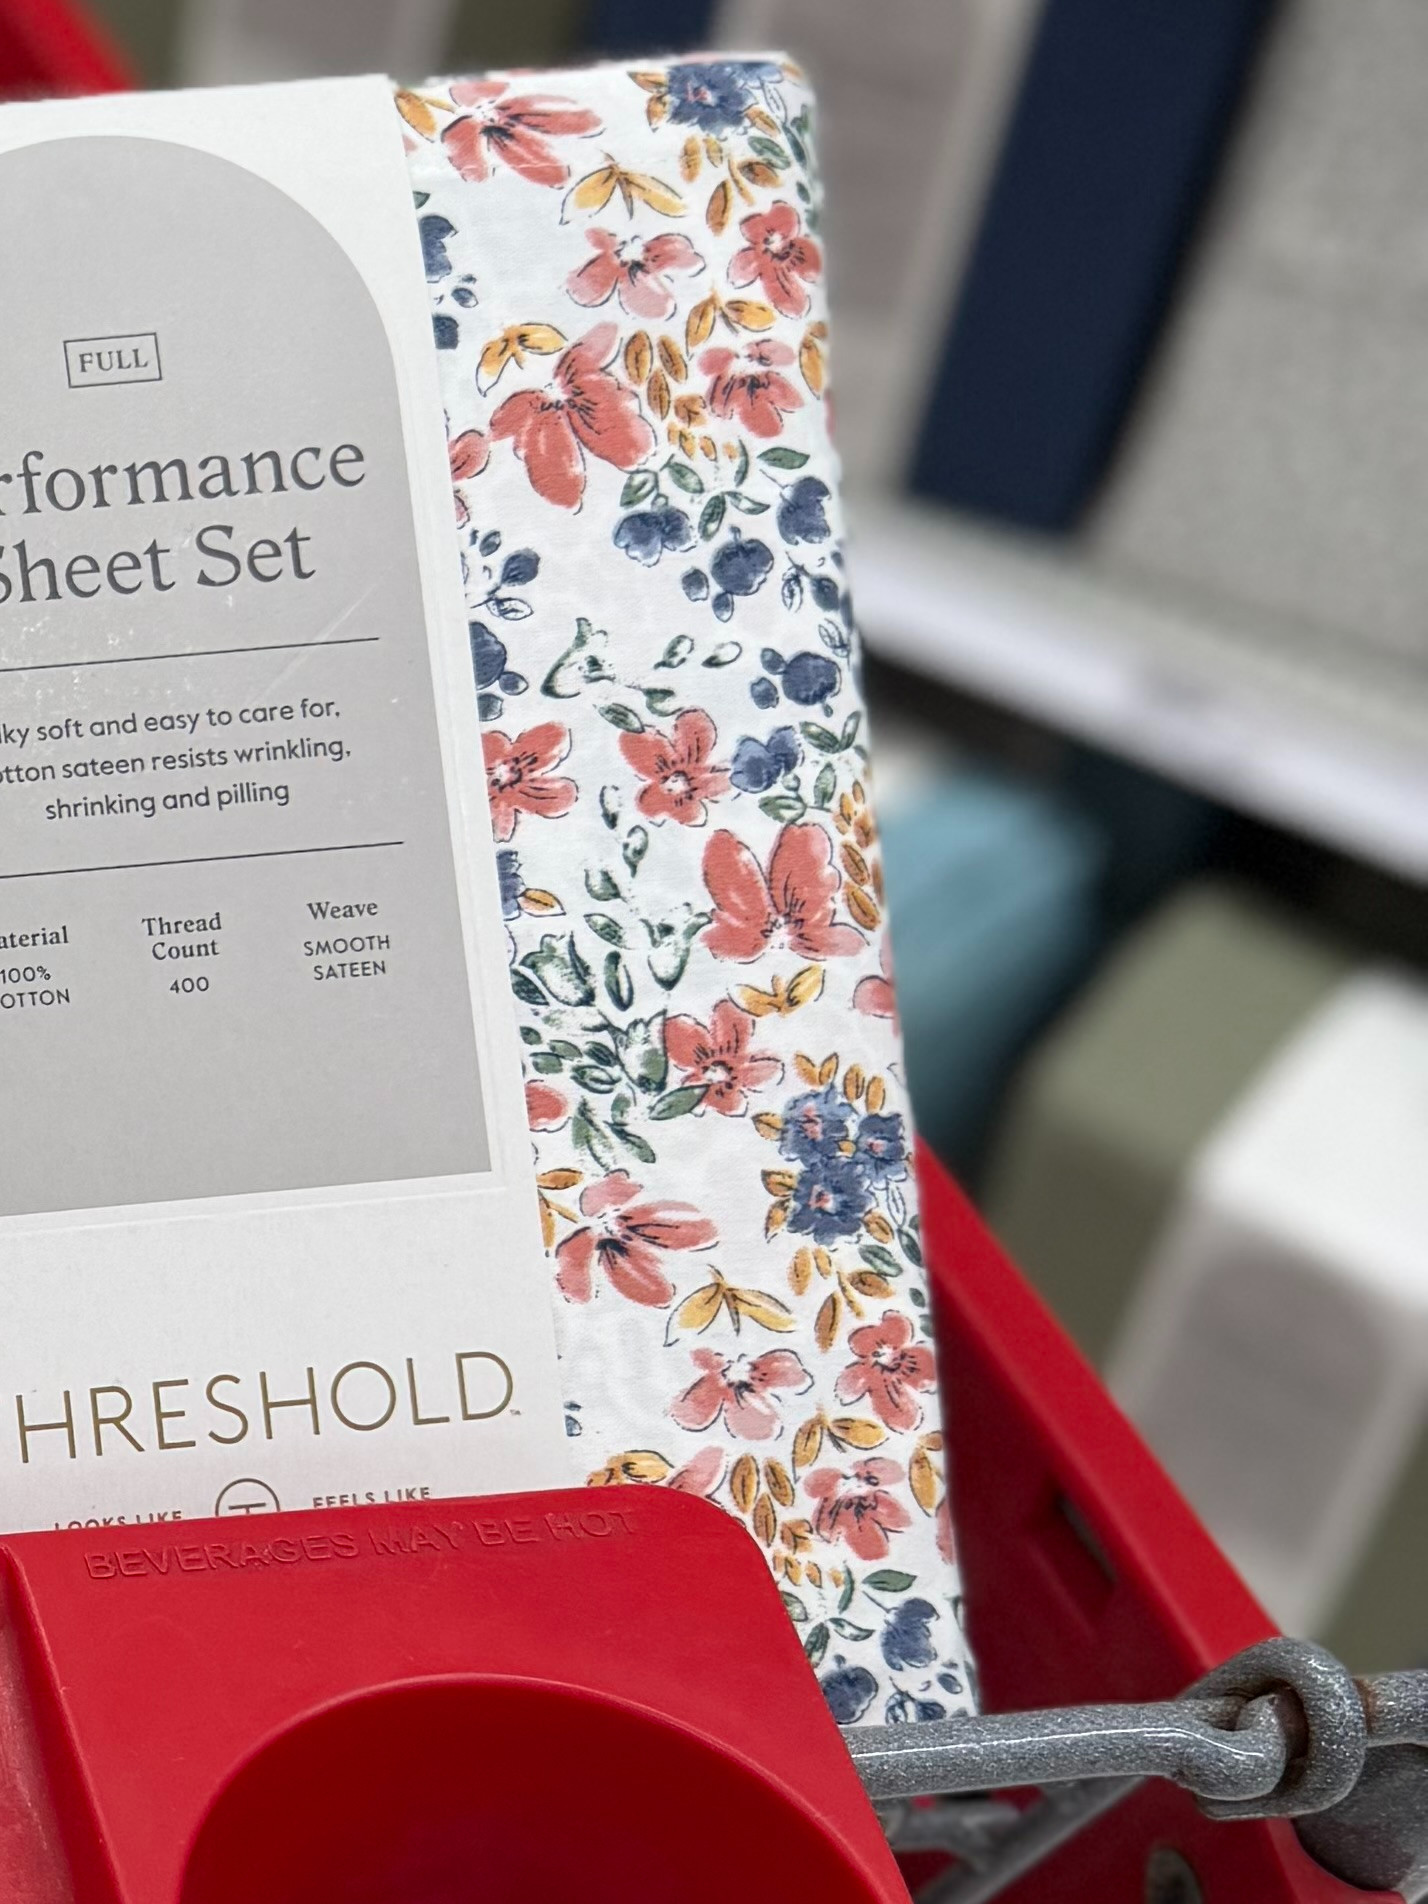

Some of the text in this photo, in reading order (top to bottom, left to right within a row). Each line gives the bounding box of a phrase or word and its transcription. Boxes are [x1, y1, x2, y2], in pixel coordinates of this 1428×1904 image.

[78, 348, 149, 373] FULL
[195, 524, 316, 587] Set
[36, 718, 85, 741] soft
[89, 712, 138, 737] and
[143, 712, 200, 735] easy
[205, 708, 233, 727] to
[238, 705, 294, 724] care
[300, 697, 341, 719] for,
[62, 757, 145, 779] sateen
[151, 747, 228, 771] resists
[233, 737, 351, 763] wrinkling,
[45, 781, 290, 820] shrinking and pilling
[306, 901, 378, 920] Weave
[141, 911, 222, 937] Thread
[151, 939, 220, 961] Count
[303, 934, 391, 957] SMOOTH
[0, 965, 52, 985] 100%
[313, 960, 386, 981] SATEEN
[169, 976, 210, 994] 400
[84, 1510, 632, 1579] BEVERAGES MAY BE HOT
